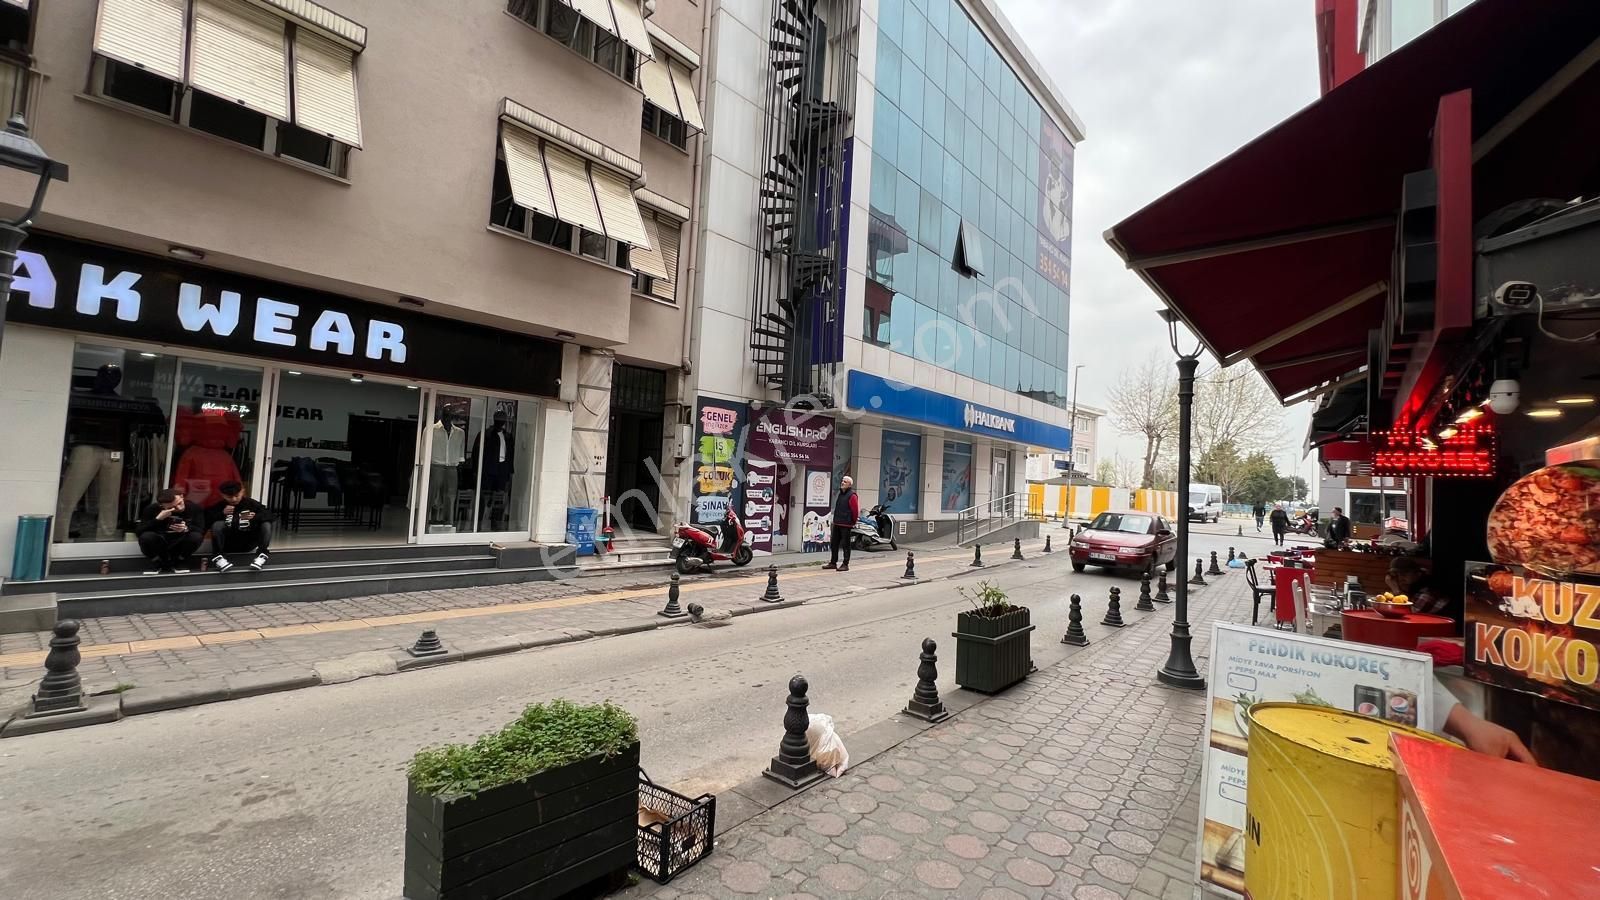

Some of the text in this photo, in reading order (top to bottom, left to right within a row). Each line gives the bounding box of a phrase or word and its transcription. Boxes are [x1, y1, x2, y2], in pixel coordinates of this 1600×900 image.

[177, 282, 407, 364] WEAR
[706, 411, 734, 424] GENEL
[975, 410, 1015, 433] HALKBANK
[756, 422, 828, 441] ENGLISH PRO
[1475, 621, 1598, 686] KOKO
[1228, 655, 1321, 679] MİDYE TAVA PORSİYON
[1257, 670, 1277, 680] MAX
